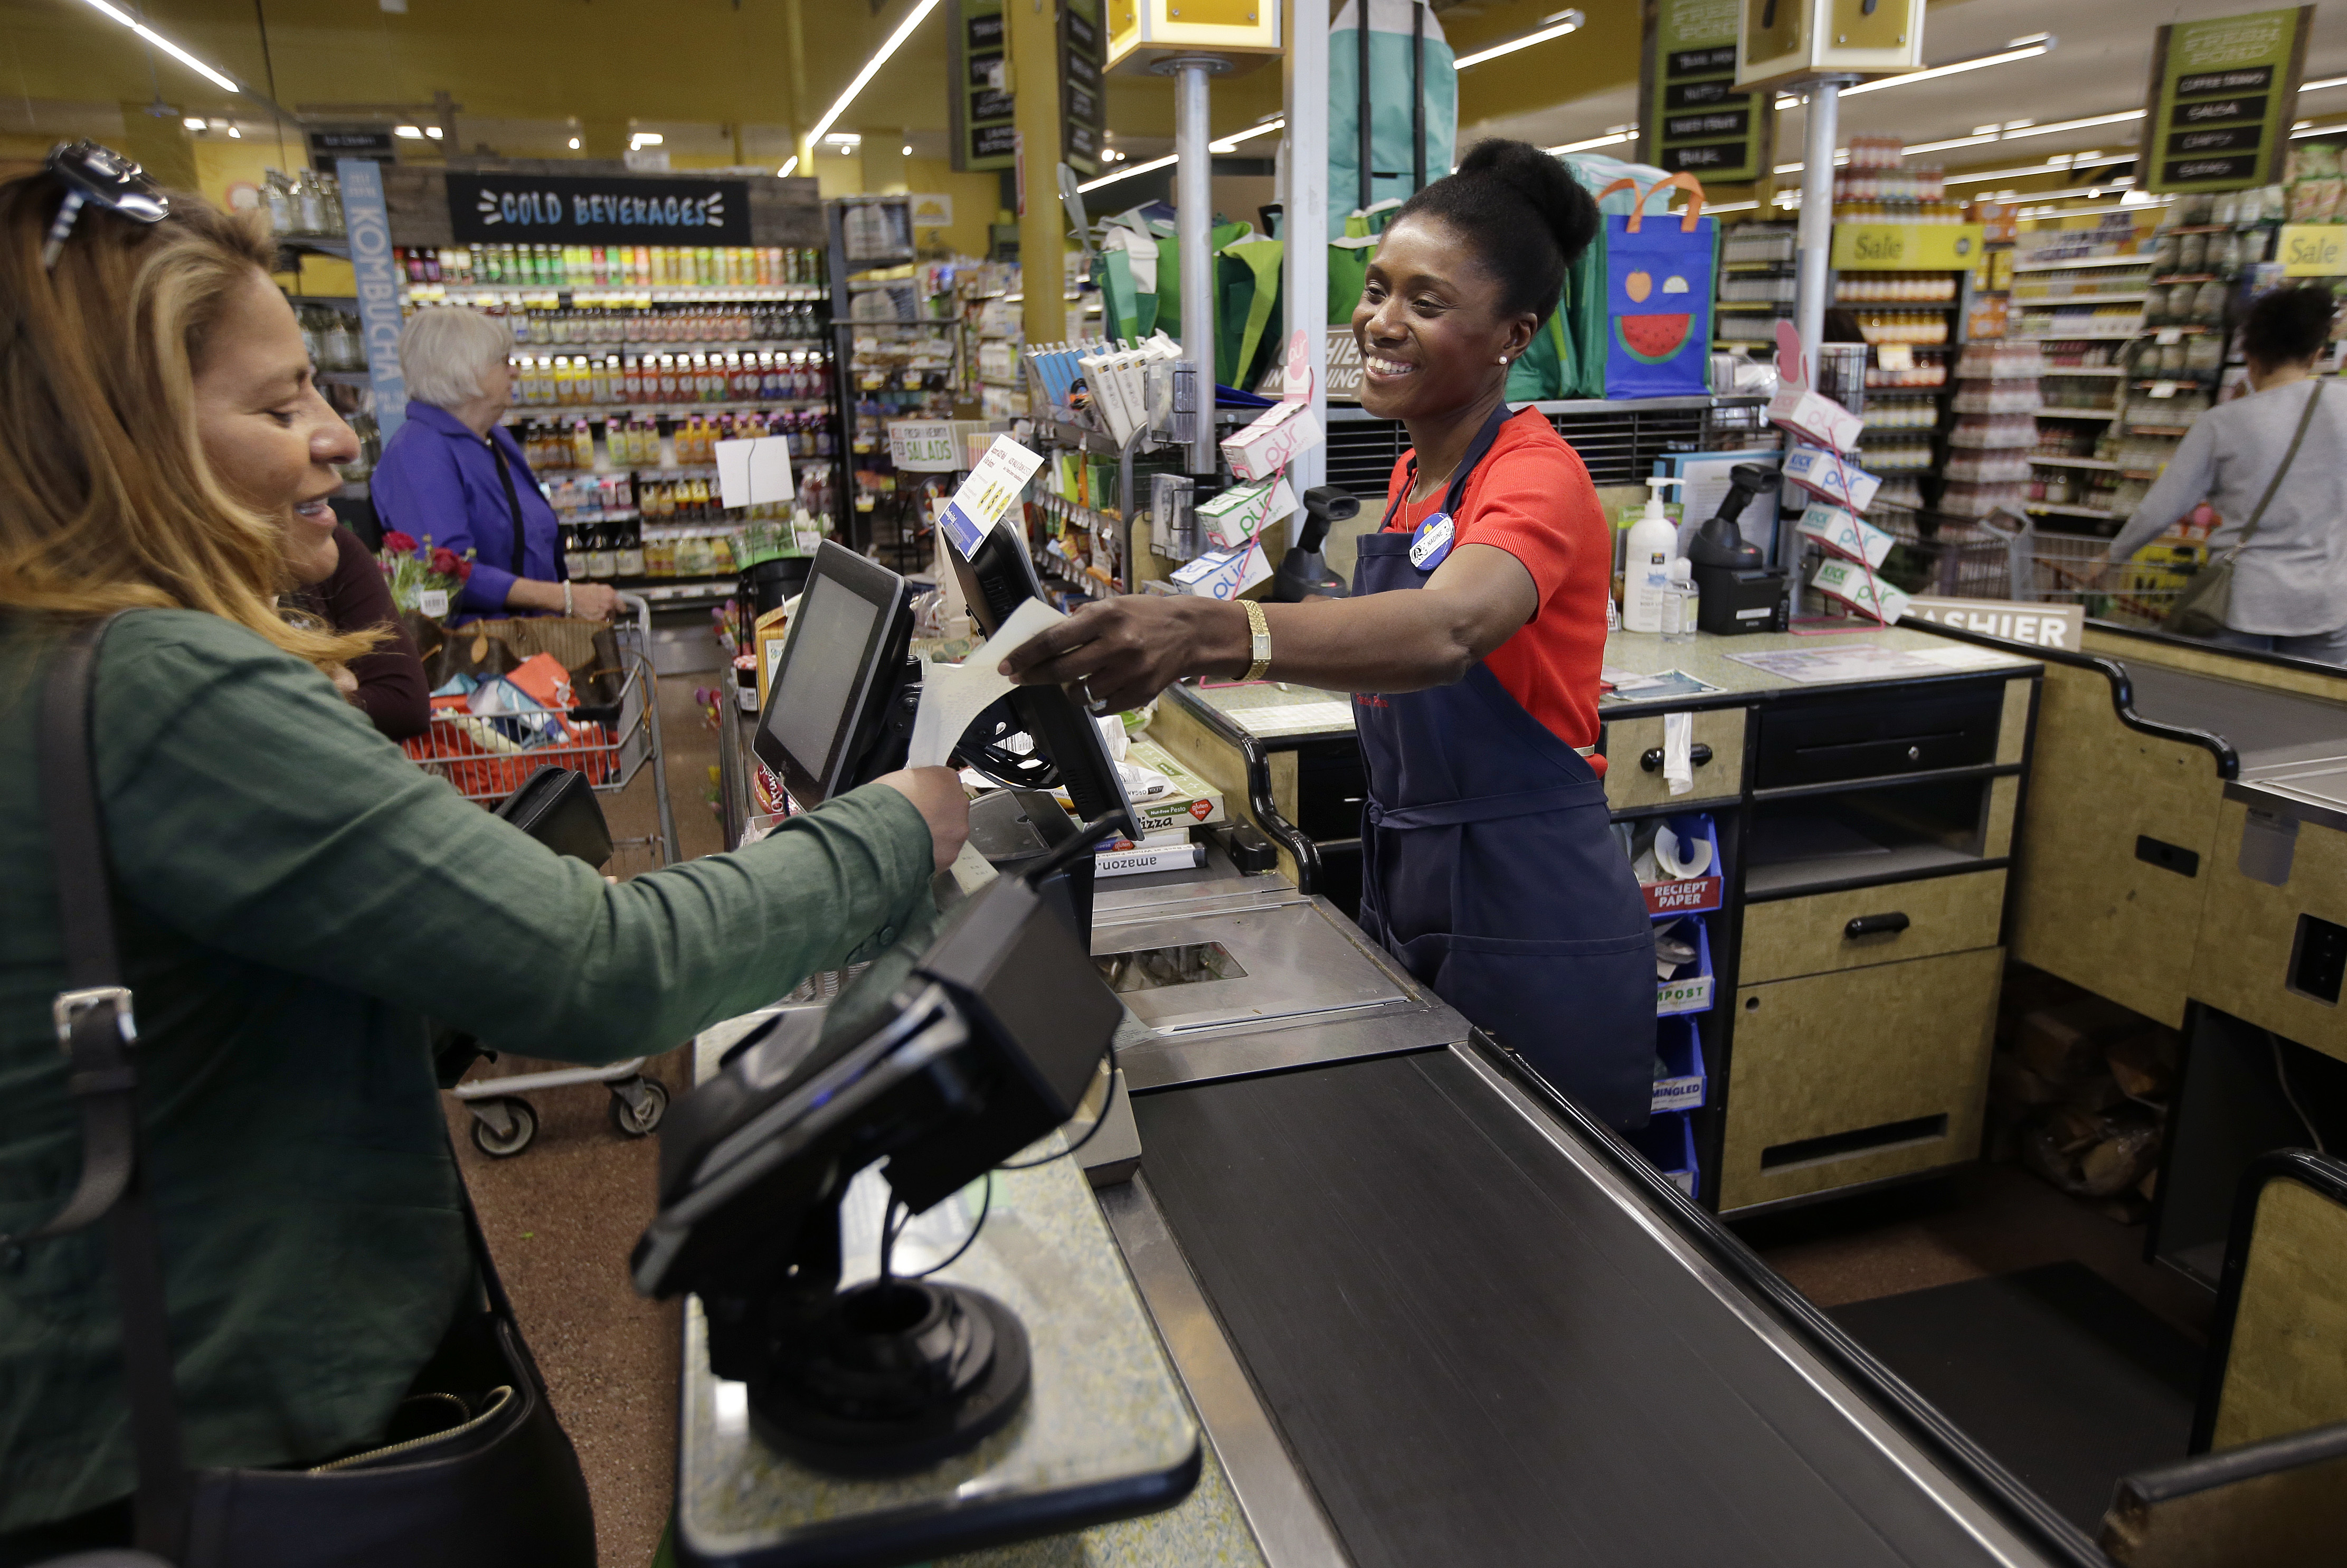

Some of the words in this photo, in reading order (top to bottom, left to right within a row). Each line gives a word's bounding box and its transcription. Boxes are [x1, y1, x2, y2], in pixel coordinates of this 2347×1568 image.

[501, 191, 563, 225] COLD
[573, 193, 707, 226] BEVERAGES
[1854, 233, 1904, 259] Sale
[2289, 236, 2339, 265] Sale
[351, 206, 402, 383] KOMBUCHA
[906, 439, 952, 461] SALADS
[1427, 530, 1443, 546] NADINE
[1900, 606, 2067, 648] SHIER
[1095, 856, 1157, 870] amazon.
[1654, 881, 1708, 898] RECIEPT
[1658, 893, 1701, 908] PAPER
[1652, 1084, 1700, 1098] MINGLED
